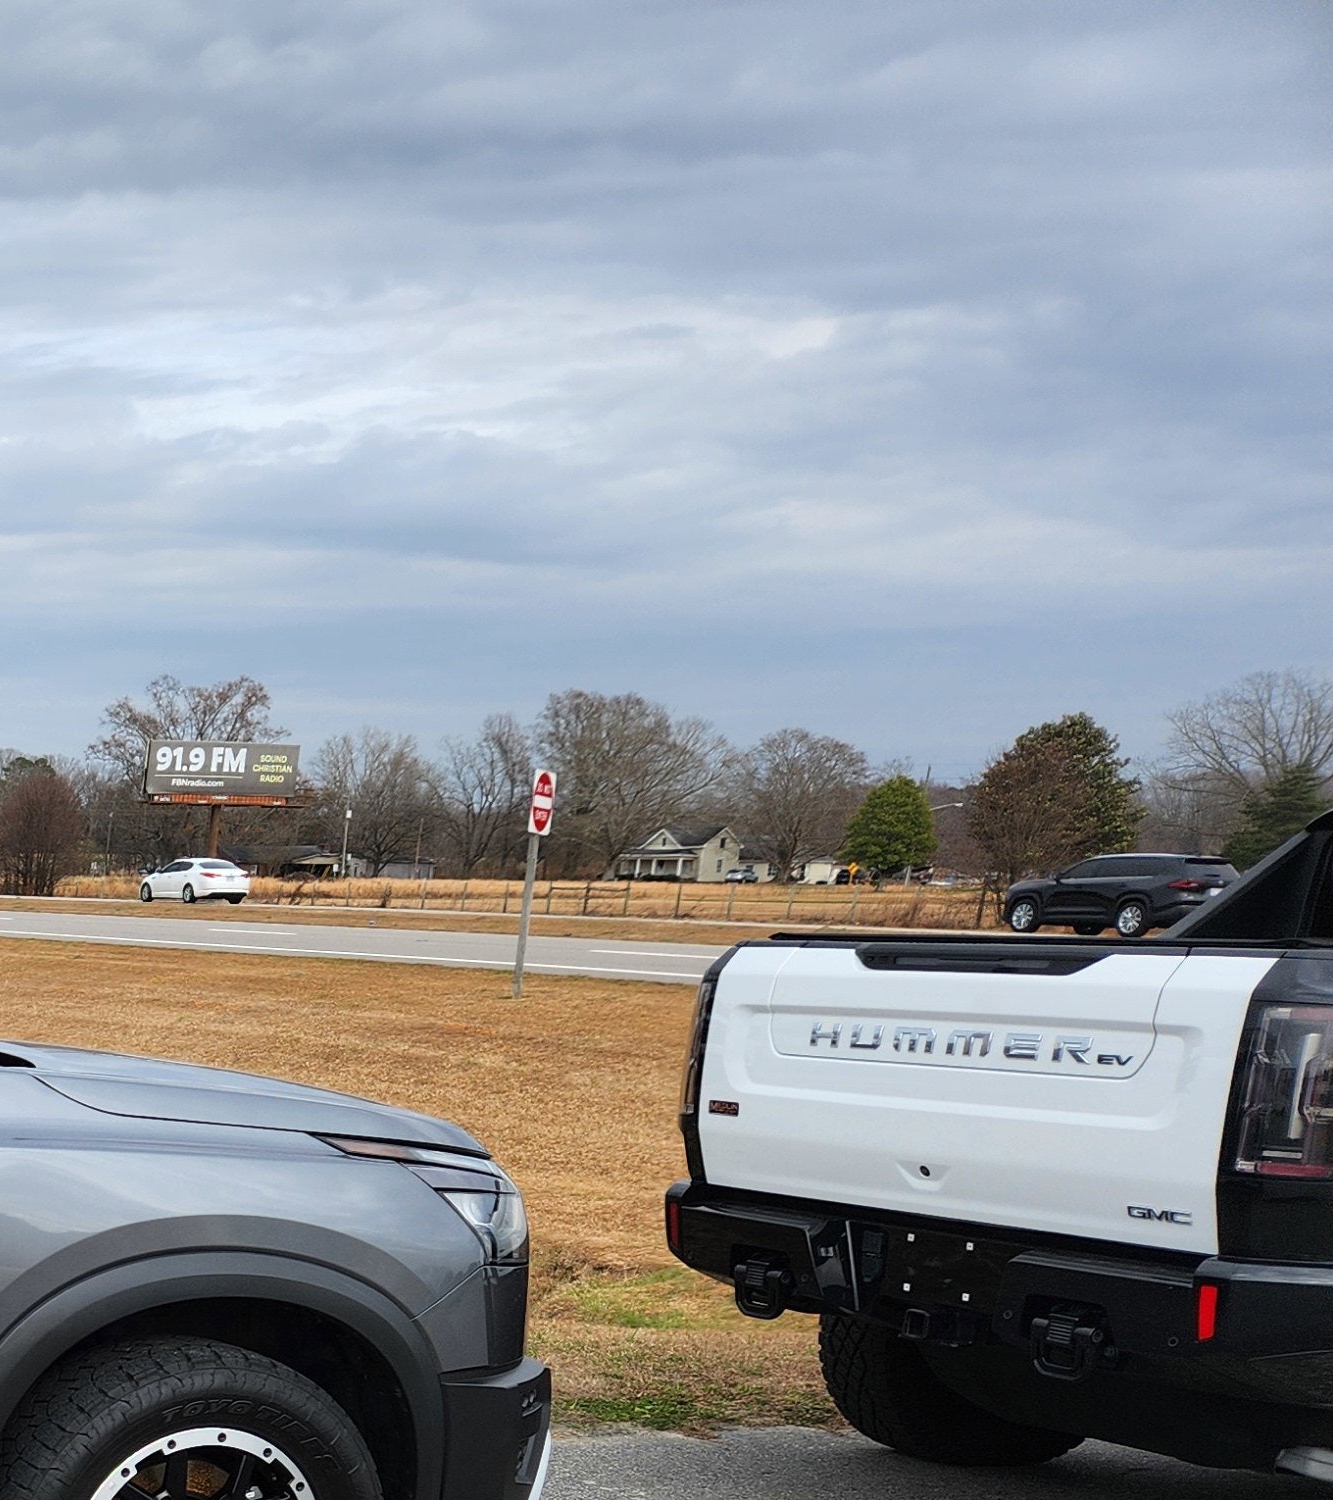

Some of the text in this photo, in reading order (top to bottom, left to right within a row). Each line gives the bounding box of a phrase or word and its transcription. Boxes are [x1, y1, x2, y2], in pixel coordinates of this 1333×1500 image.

[156, 746, 248, 773] 91.9 FM
[260, 754, 288, 764] SOUND
[252, 764, 293, 774] CHRISTIAN
[171, 778, 225, 788] FBNradio.com
[259, 774, 285, 784] RADIO
[809, 1022, 1134, 1067] HUMMER EV
[1127, 1205, 1193, 1226] GMC
